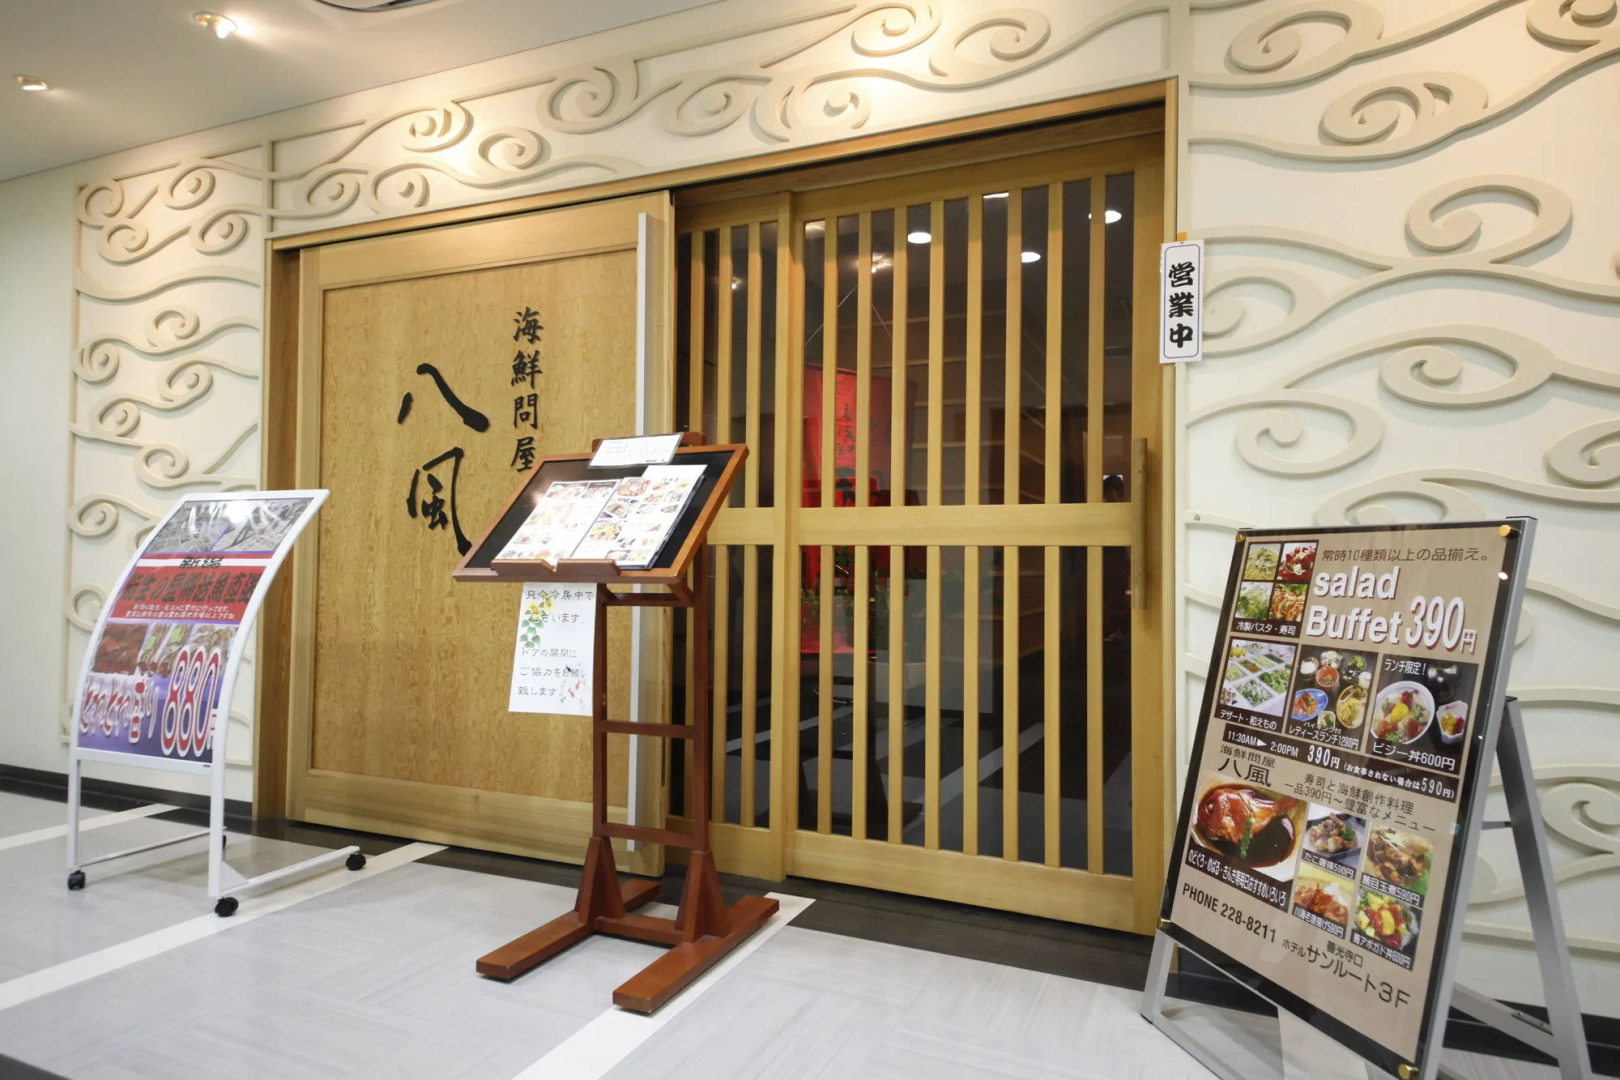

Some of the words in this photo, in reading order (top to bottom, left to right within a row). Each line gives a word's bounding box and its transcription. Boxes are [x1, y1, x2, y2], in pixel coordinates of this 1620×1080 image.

[1168, 261, 1196, 349] 営業中
[510, 306, 545, 473] 海鮮問屋
[397, 362, 490, 557] 八風
[1313, 566, 1401, 600] salad
[1305, 604, 1404, 645] Buffet
[517, 686, 558, 697] 致します
[1219, 744, 1276, 769] 海鮮問屋
[1227, 730, 1258, 748] 11:30AM
[1270, 741, 1299, 758] 2:00PM
[1217, 757, 1272, 787] 八風
[1182, 882, 1219, 913] PHONE
[1220, 903, 1276, 943] 228-8211
[1326, 940, 1364, 968] 善光寺口
